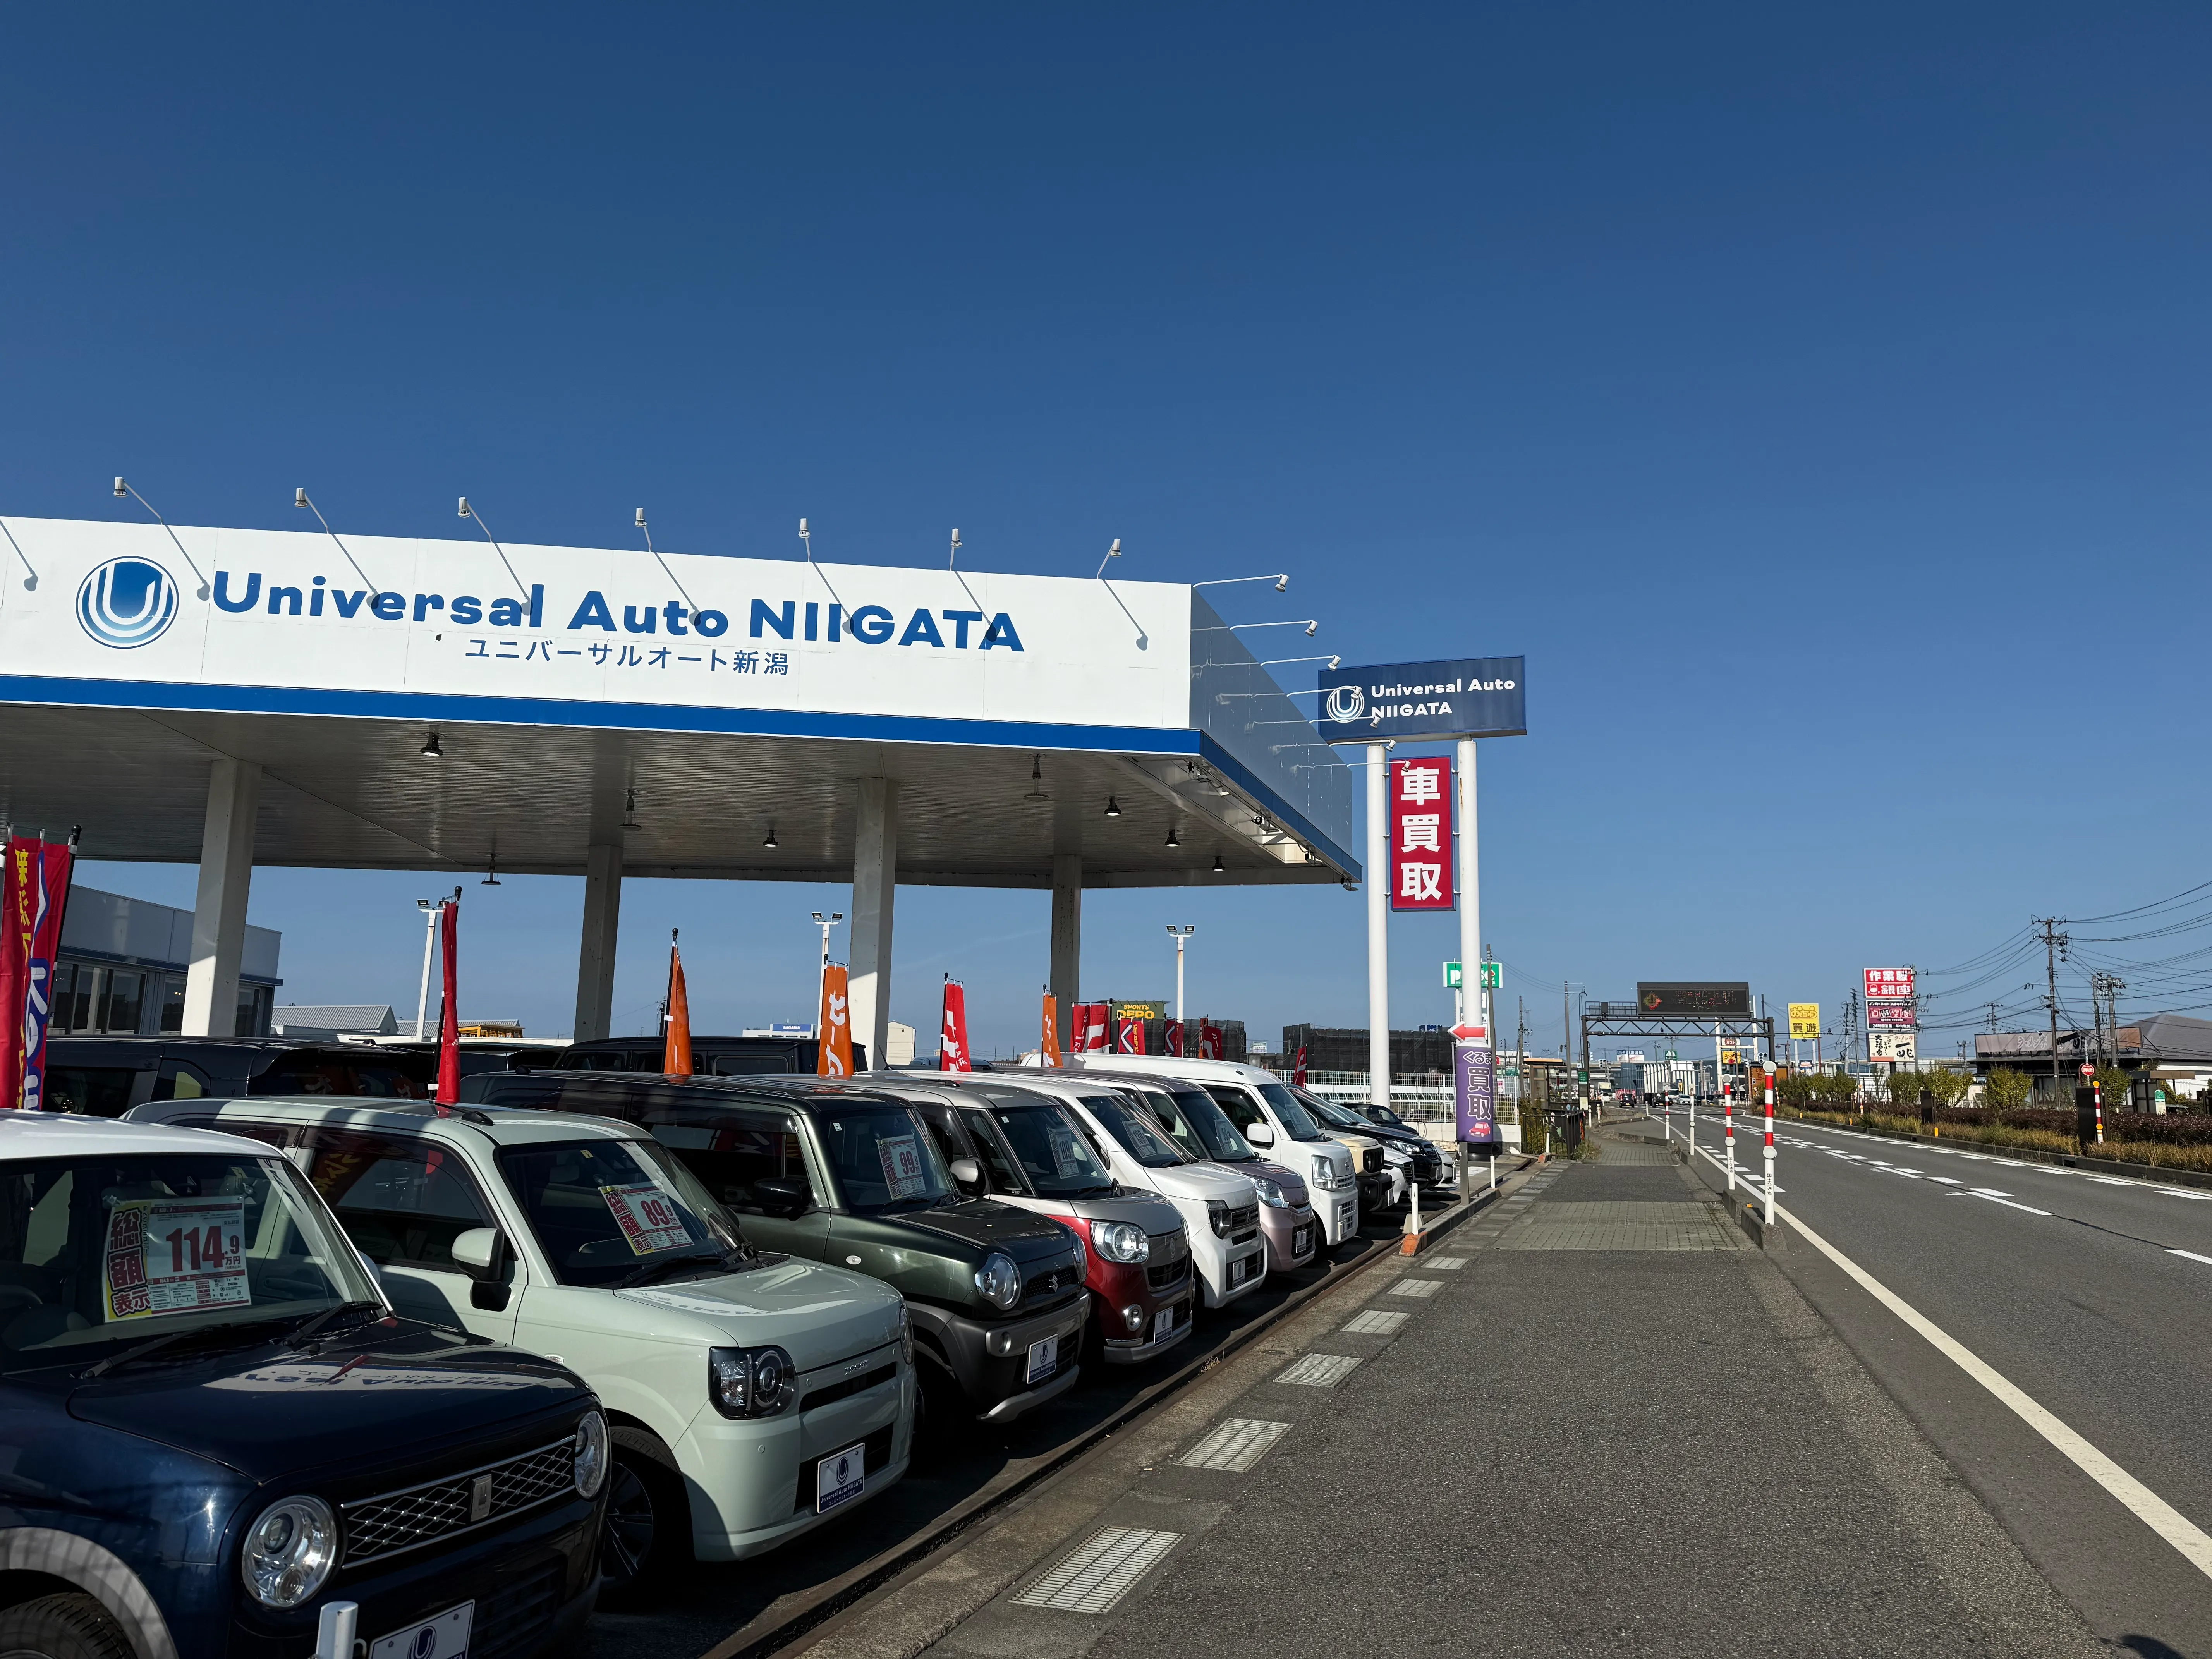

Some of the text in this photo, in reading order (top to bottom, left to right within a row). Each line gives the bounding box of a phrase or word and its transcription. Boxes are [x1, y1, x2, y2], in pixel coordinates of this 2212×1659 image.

[213, 570, 1025, 652] Universal Auto NIIGATA
[465, 639, 789, 676] ユニバーサルオート新潟
[1371, 678, 1515, 697] Universal Auto
[1371, 702, 1453, 718] NIIGATA
[1400, 766, 1442, 900] 車買取
[1881, 984, 1911, 995] 銀座
[1793, 1023, 1803, 1032] 買
[1463, 1051, 1492, 1064] くるま
[1467, 1067, 1491, 1120] 買取
[108, 1209, 146, 1291] 総額
[225, 1256, 241, 1266] 万円
[112, 1288, 150, 1316] 表示
[820, 1490, 838, 1503] Universal
